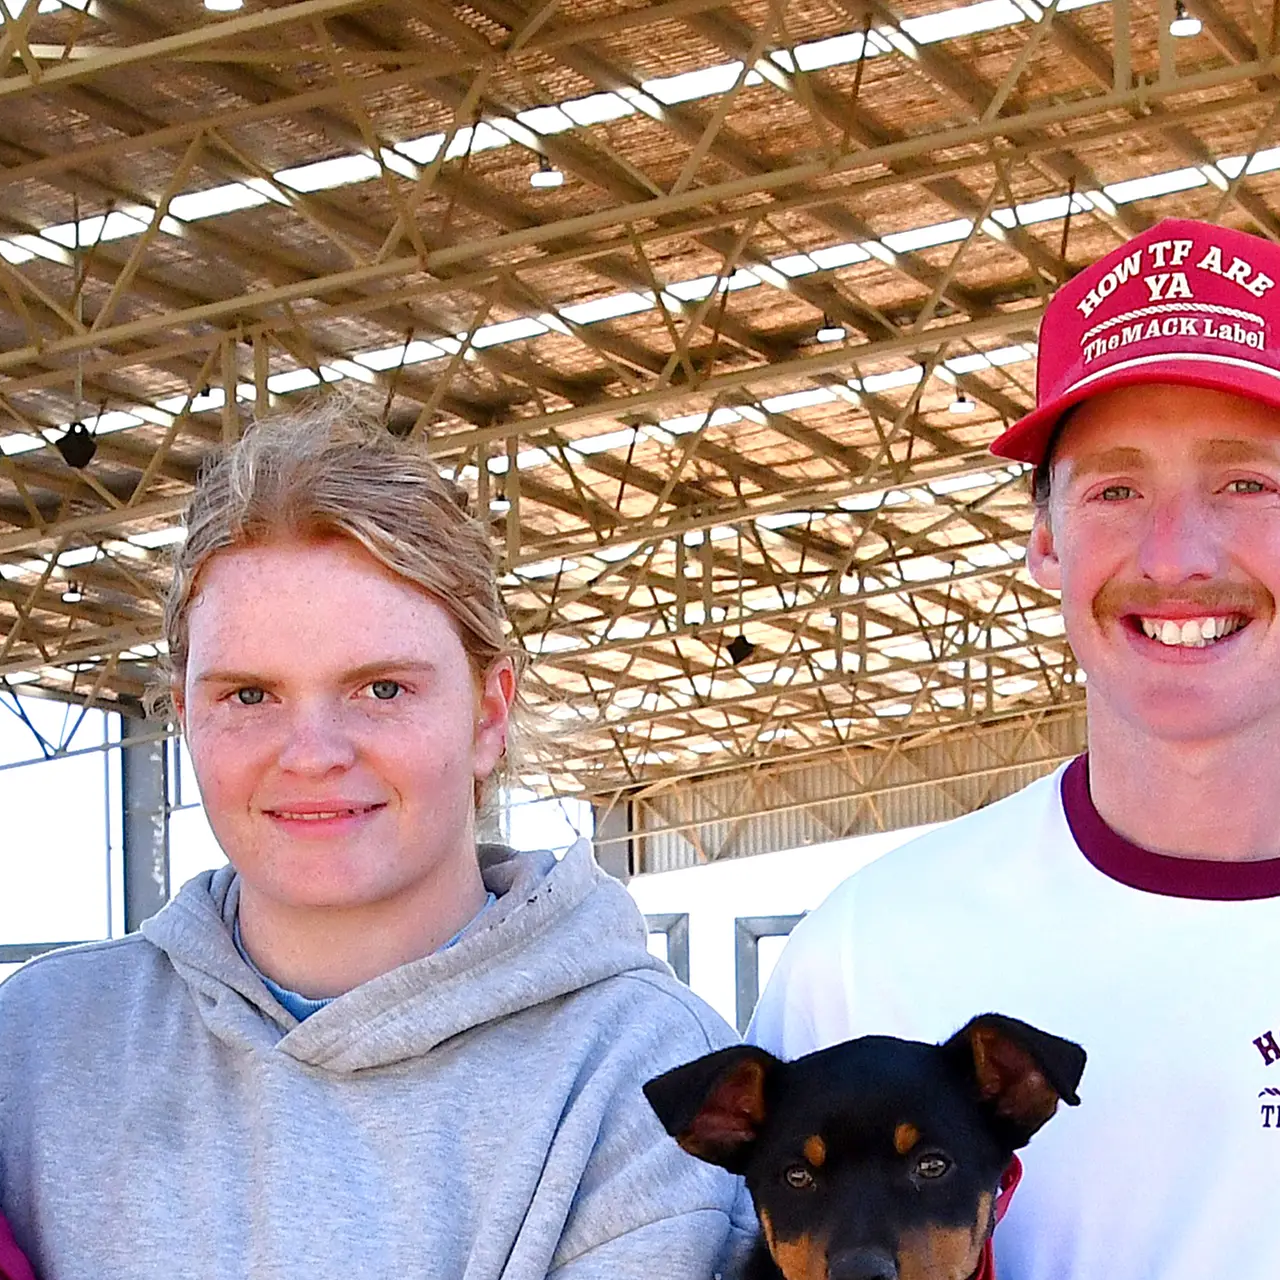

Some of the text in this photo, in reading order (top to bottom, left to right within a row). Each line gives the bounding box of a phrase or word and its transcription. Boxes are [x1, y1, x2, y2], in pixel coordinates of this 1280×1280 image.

[1076, 240, 1275, 319] HOW TF ARE
[1144, 272, 1193, 302] YA
[1203, 319, 1266, 351] Label
